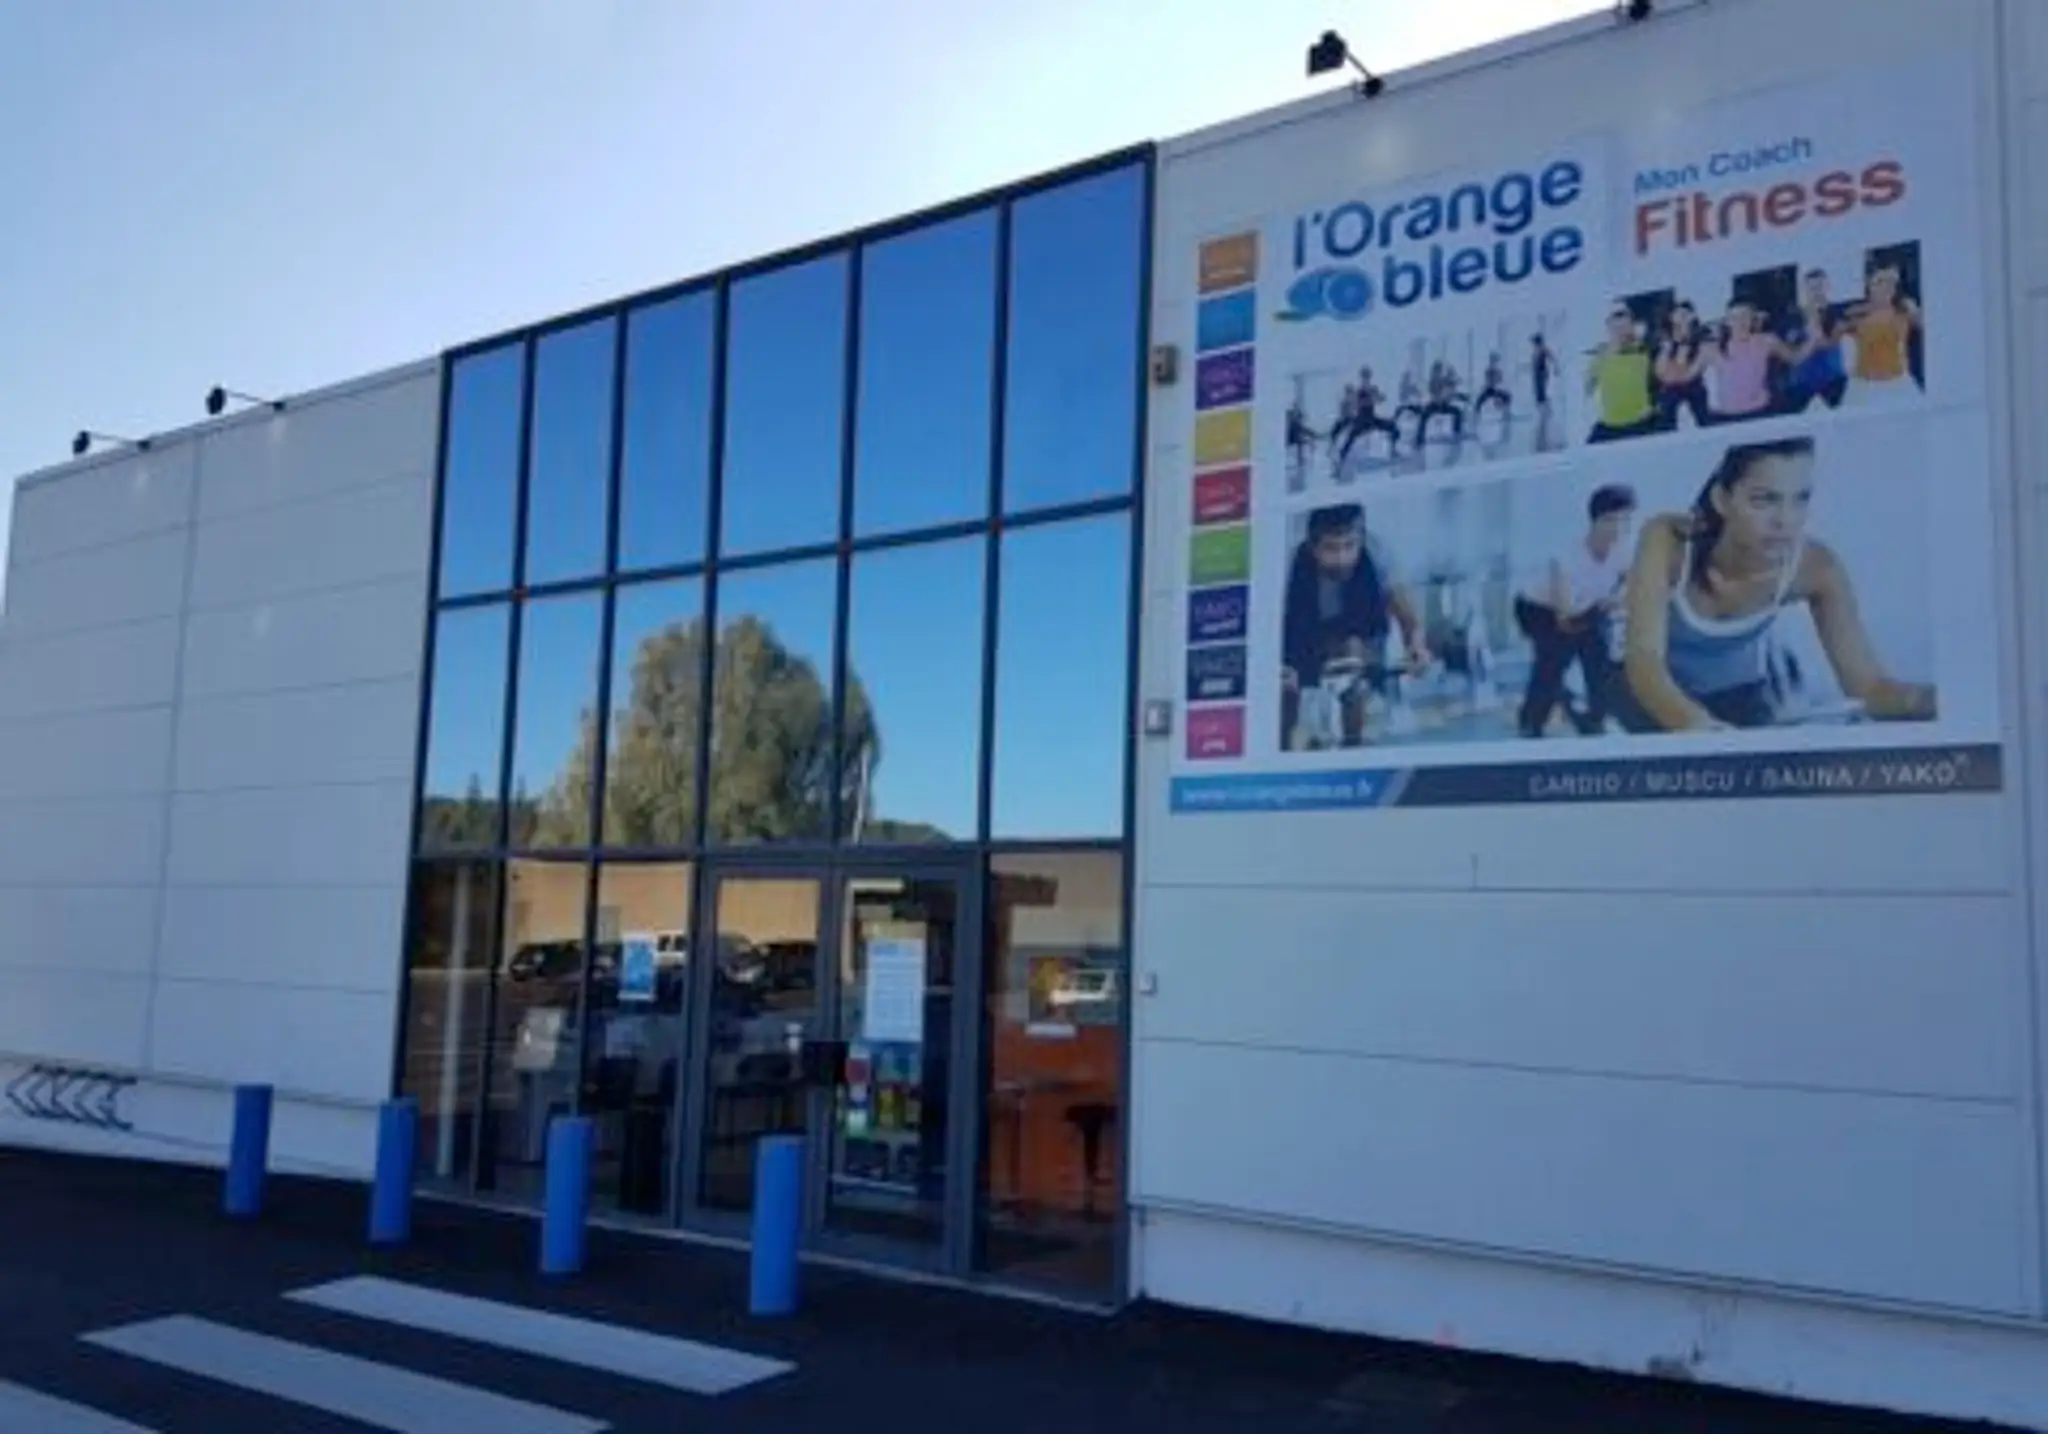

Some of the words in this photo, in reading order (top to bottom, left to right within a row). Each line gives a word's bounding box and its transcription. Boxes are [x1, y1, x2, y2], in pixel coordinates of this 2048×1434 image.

[1634, 164, 1699, 194] Mon
[1708, 136, 1812, 177] Coach
[1636, 160, 1906, 255] Fitness
[1293, 160, 1582, 269] l'Orange
[1382, 225, 1583, 308] bleue
